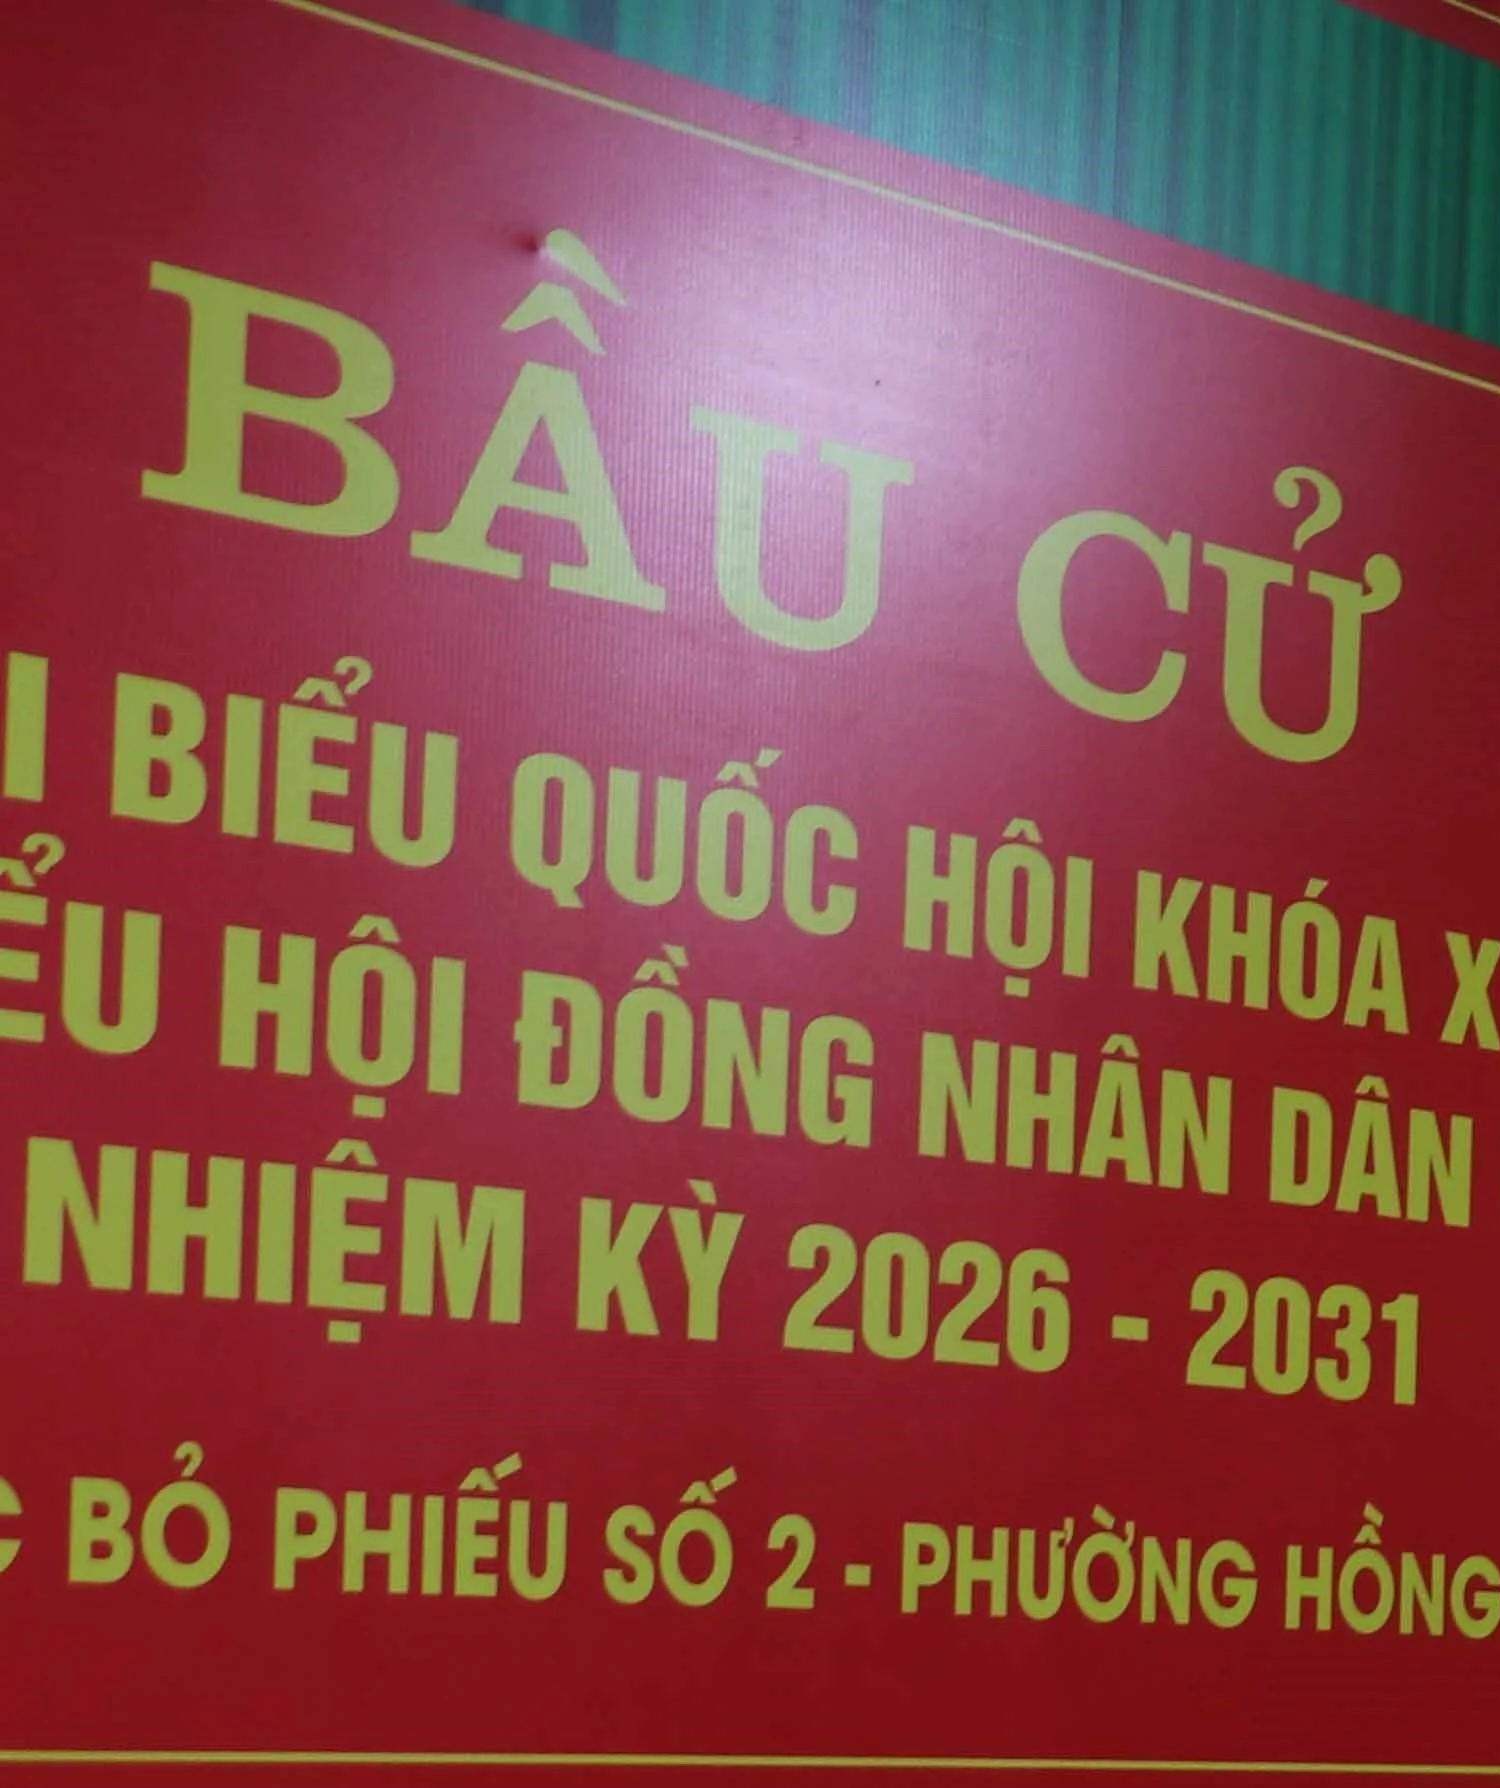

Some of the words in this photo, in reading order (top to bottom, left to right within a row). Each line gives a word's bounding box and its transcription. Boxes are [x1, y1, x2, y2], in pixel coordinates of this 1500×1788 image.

[140, 230, 914, 653] BẦU
[1017, 466, 1403, 764] CỬ
[110, 655, 457, 868] BIỂU
[509, 748, 857, 934] QUỐC
[904, 818, 1093, 1000] HỘI
[1132, 869, 1408, 1034] KHÓA
[218, 914, 465, 1119] HỘI
[514, 942, 874, 1148] ĐỒNG
[917, 1033, 1233, 1195] NHÂN
[1270, 1075, 1473, 1228] DÂN
[22, 1137, 525, 1345] NHIỆM
[577, 1179, 743, 1342] KỲ
[783, 1223, 1071, 1373] 2026
[1111, 1315, 1149, 1341] -
[1185, 1269, 1419, 1405] 2031
[68, 1441, 231, 1589] BỎ
[273, 1453, 568, 1601] PHIẾU
[602, 1467, 737, 1607] SỐ
[765, 1514, 815, 1610] 2
[844, 1564, 871, 1587] -
[901, 1506, 1258, 1628] PHƯỜNG
